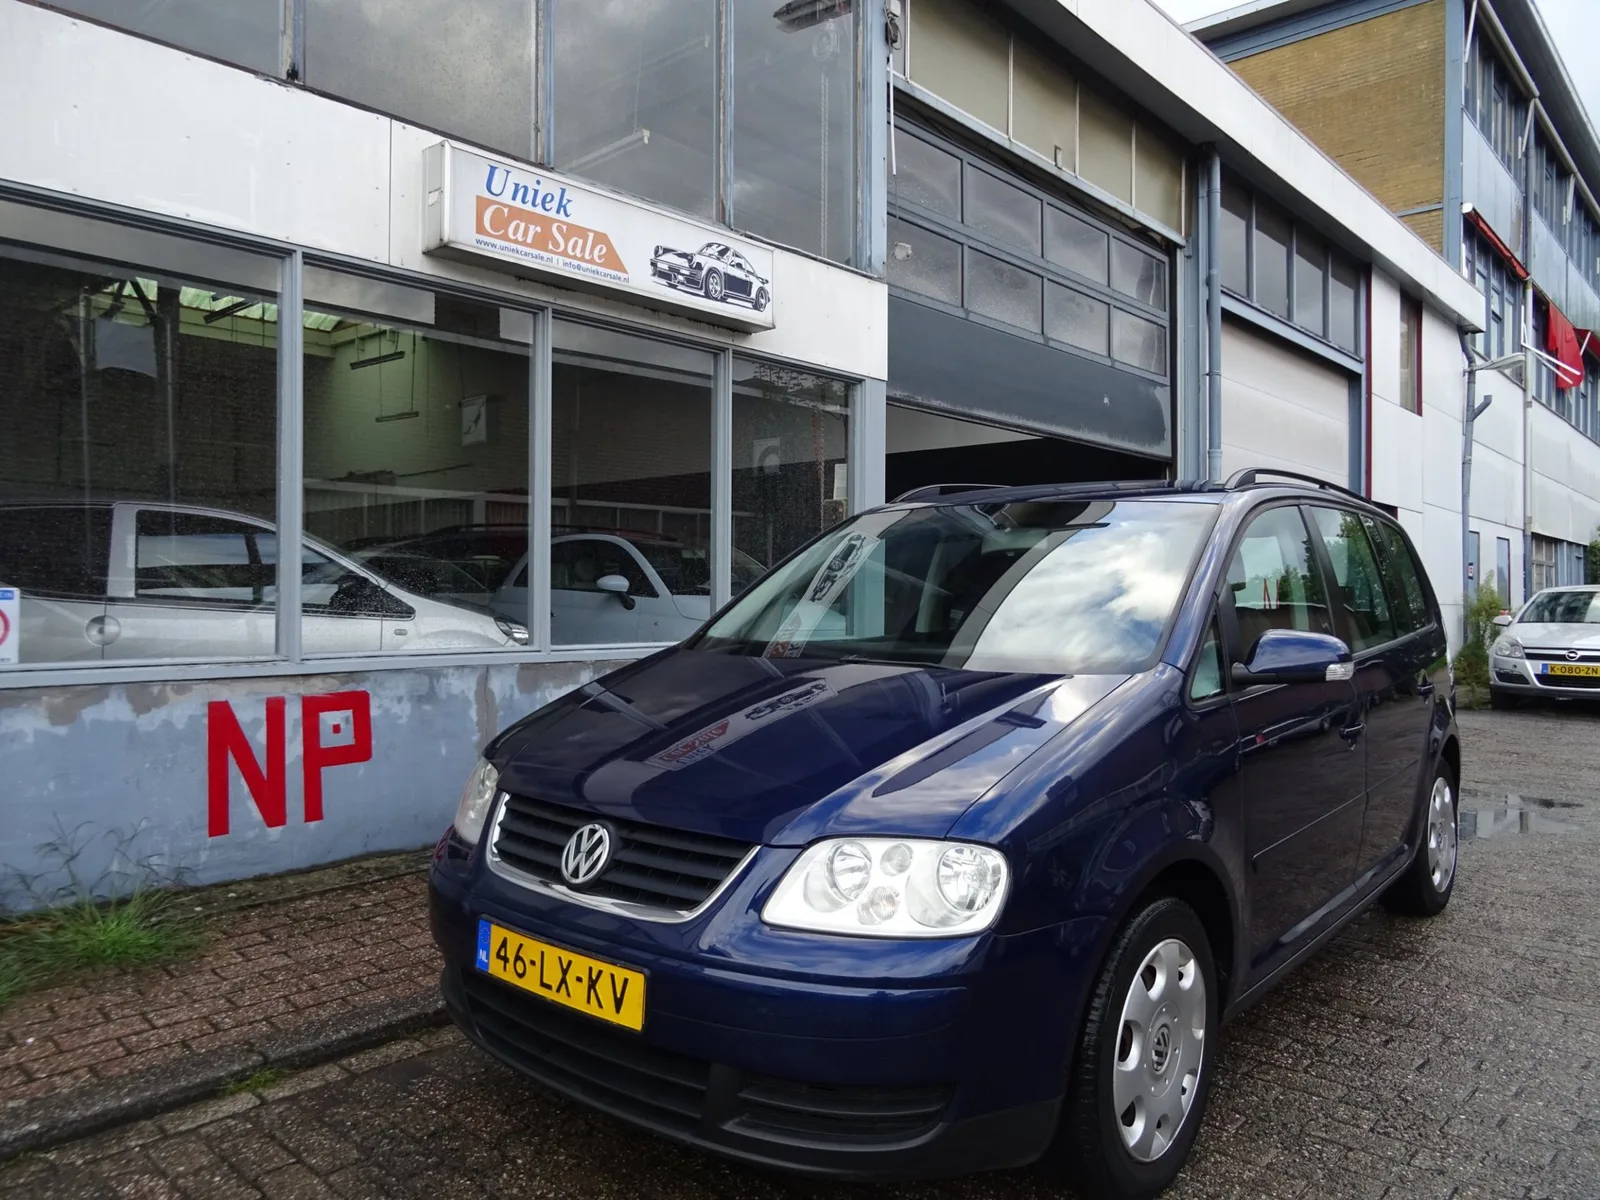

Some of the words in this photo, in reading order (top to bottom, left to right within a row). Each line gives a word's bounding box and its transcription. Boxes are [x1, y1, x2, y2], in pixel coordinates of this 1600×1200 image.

[485, 163, 573, 218] Uniek
[475, 238, 554, 264] www.uniekcarsale.nl
[562, 259, 630, 284] info@uniekcarsale.nl
[483, 204, 542, 244] Car
[548, 222, 607, 263] Sale
[1550, 665, 1598, 675] K-080-ZN
[207, 690, 373, 838] NP
[479, 948, 489, 963] NL
[495, 936, 629, 1015] 46-LX-KV
